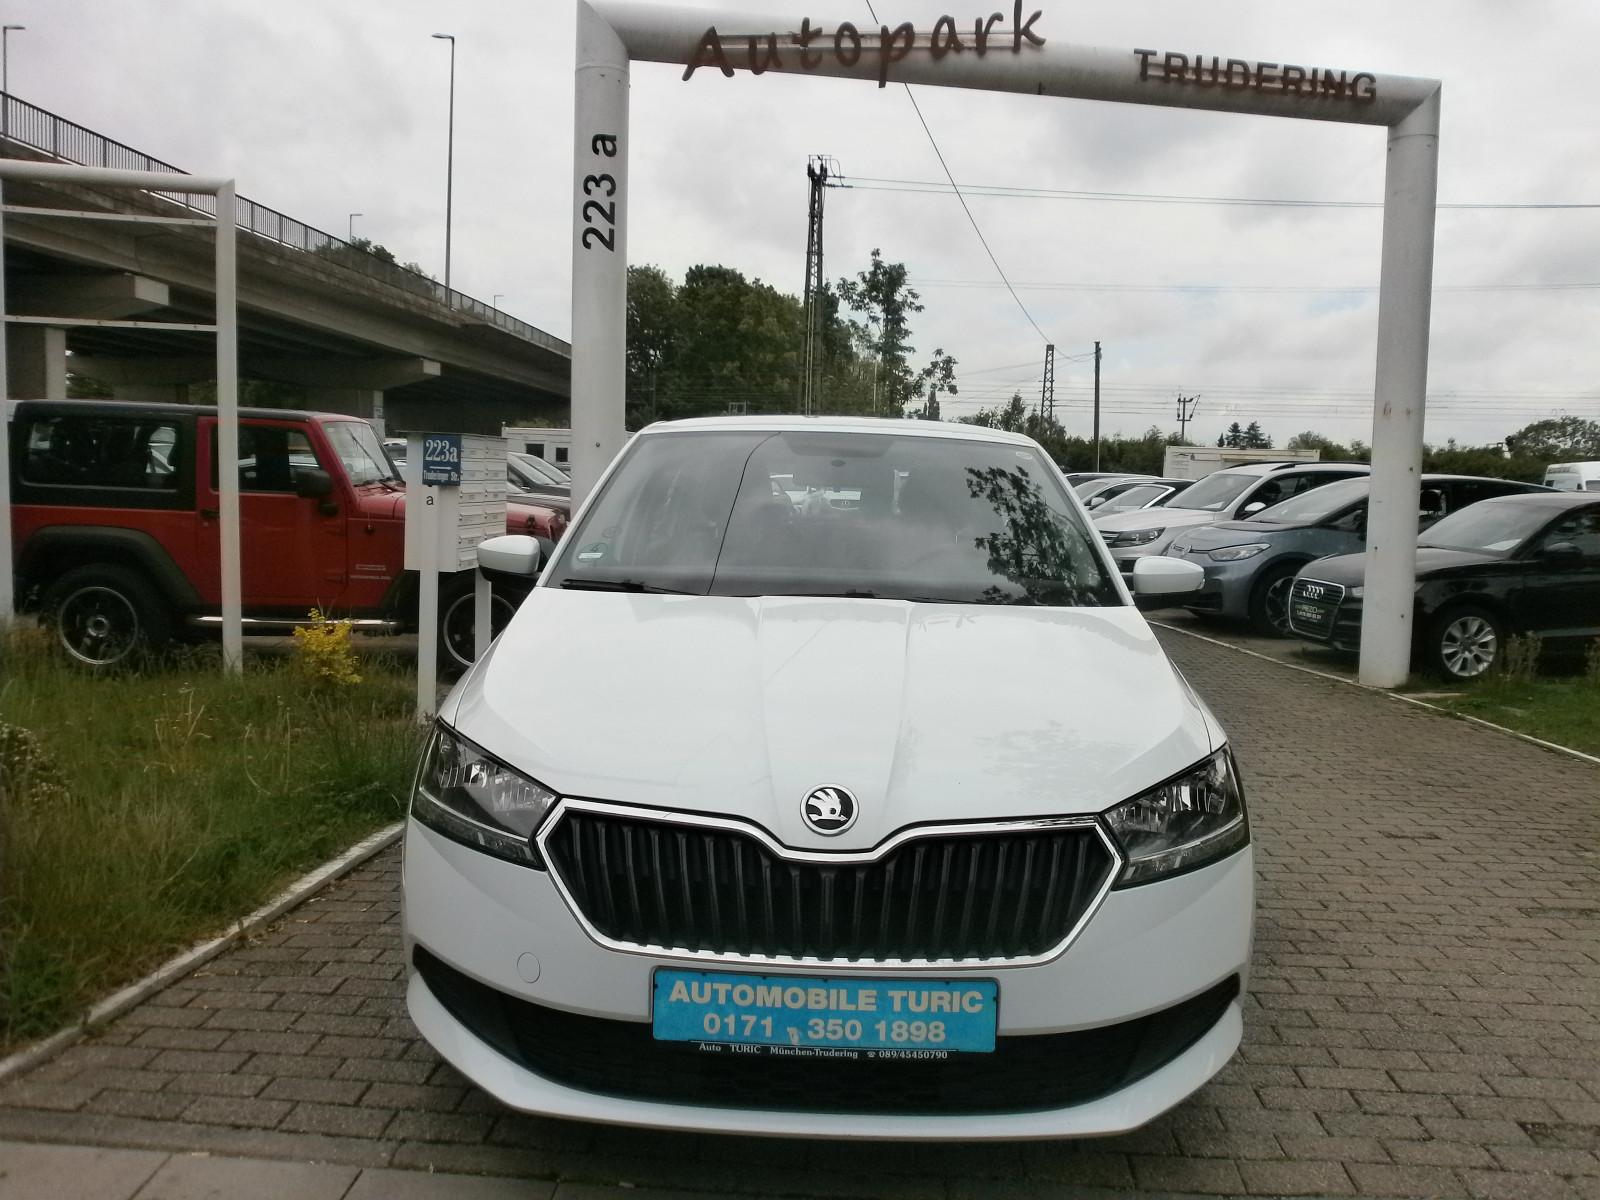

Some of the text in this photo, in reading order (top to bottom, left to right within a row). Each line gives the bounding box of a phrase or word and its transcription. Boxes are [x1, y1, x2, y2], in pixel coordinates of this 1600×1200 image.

[682, 0, 1046, 88] Autopark
[1133, 48, 1377, 101] TRUDERING
[581, 133, 617, 252] 223 a
[425, 439, 459, 463] 223a
[426, 495, 434, 506] a
[668, 980, 984, 1014] AUTOMOBILE TURIC
[703, 1012, 946, 1043] 0171 350 1898
[699, 1042, 722, 1052] Auto
[729, 1043, 761, 1054] TURIC
